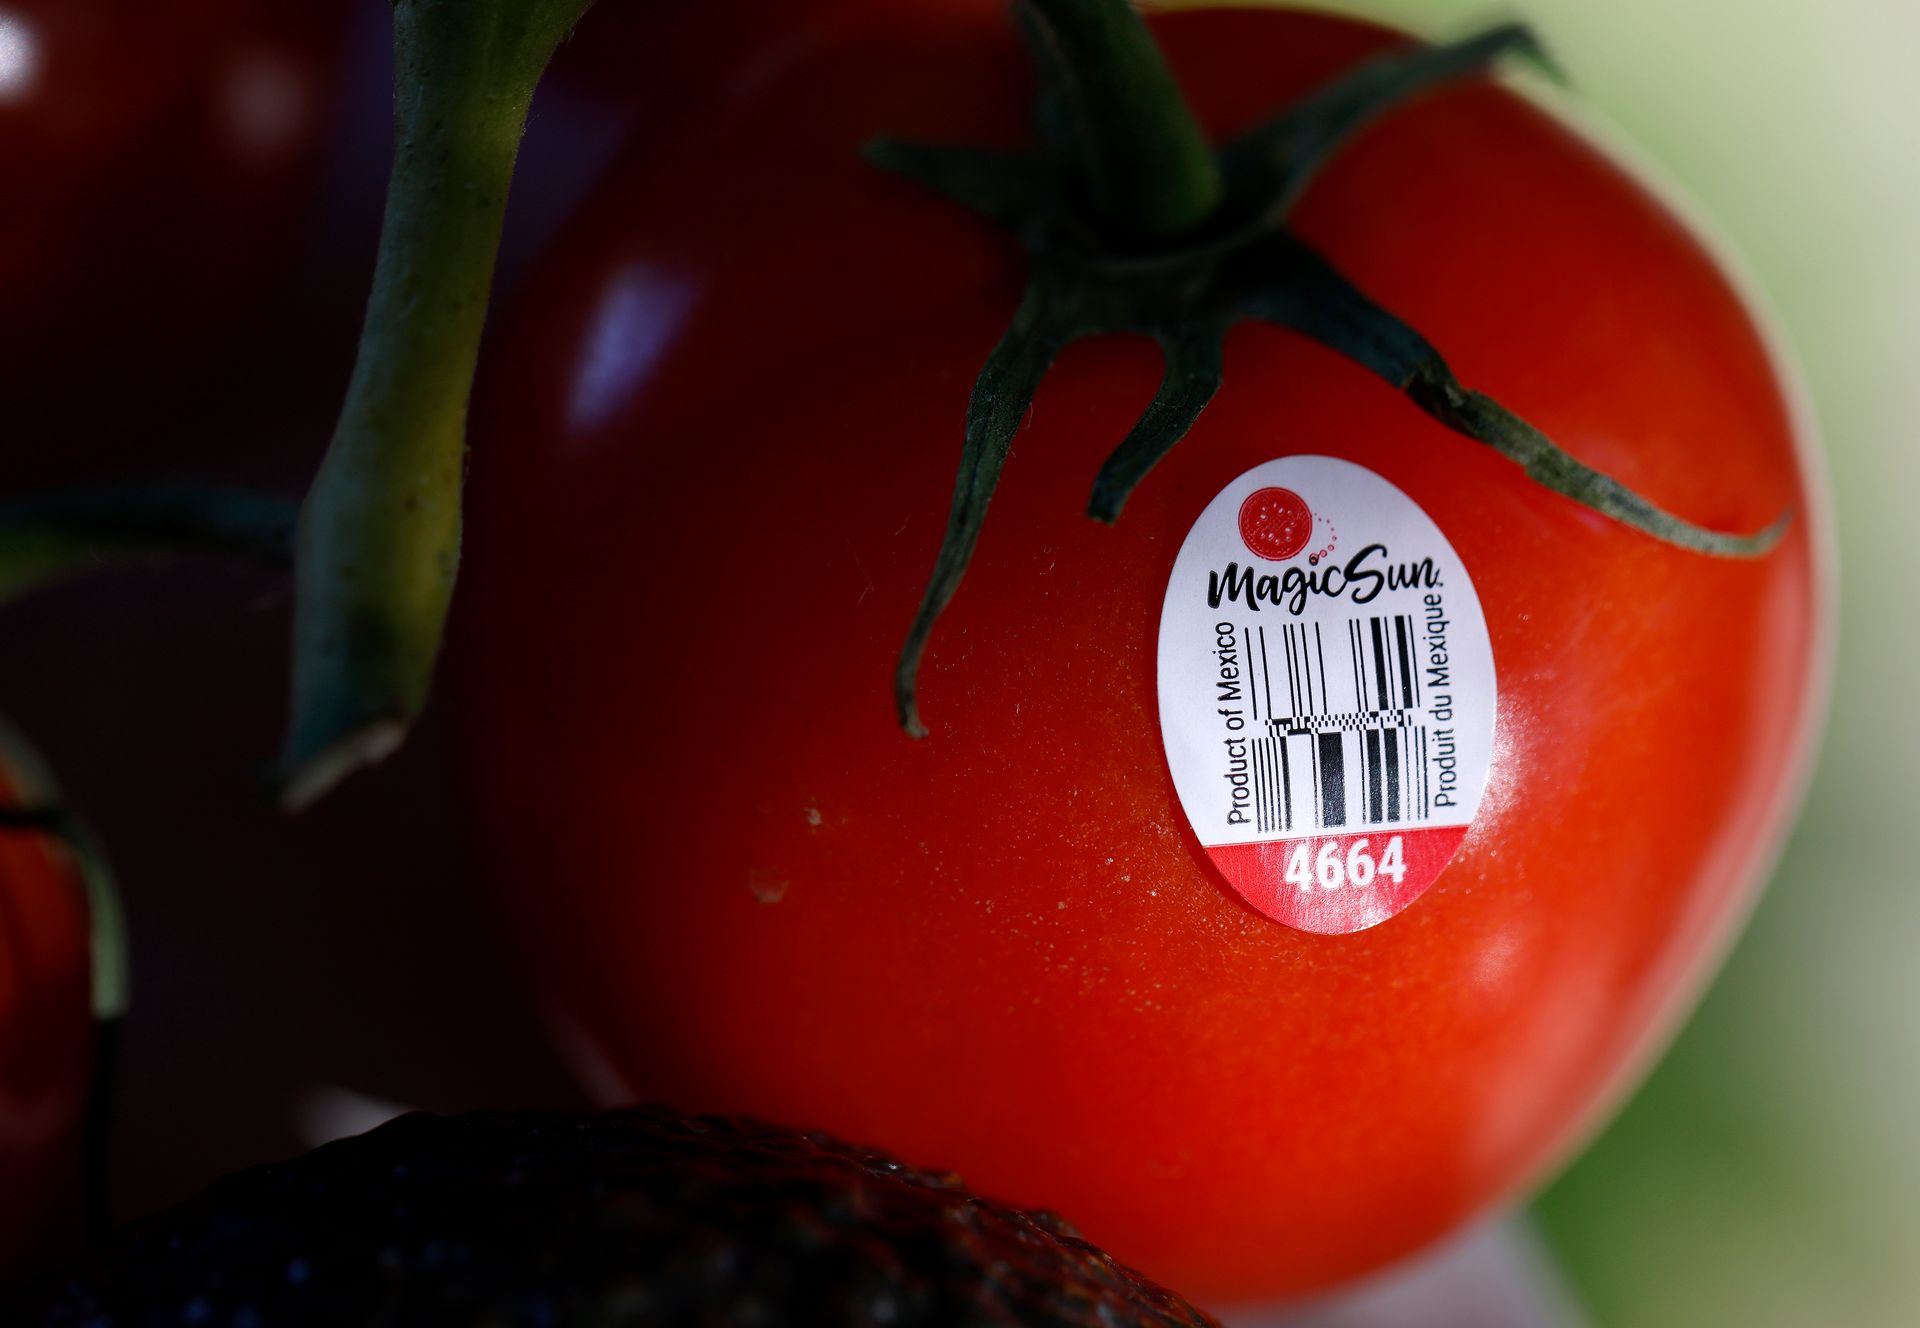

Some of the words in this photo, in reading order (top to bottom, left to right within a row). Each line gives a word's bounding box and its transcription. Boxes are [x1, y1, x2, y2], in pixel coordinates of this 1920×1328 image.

[1212, 621, 1242, 701] Mexico
[1423, 593, 1450, 688] Mexique
[1217, 708, 1245, 731] of
[1428, 694, 1454, 722] du
[1223, 736, 1252, 825] Product
[1432, 728, 1458, 808] Produit
[1285, 835, 1407, 891] 4664
